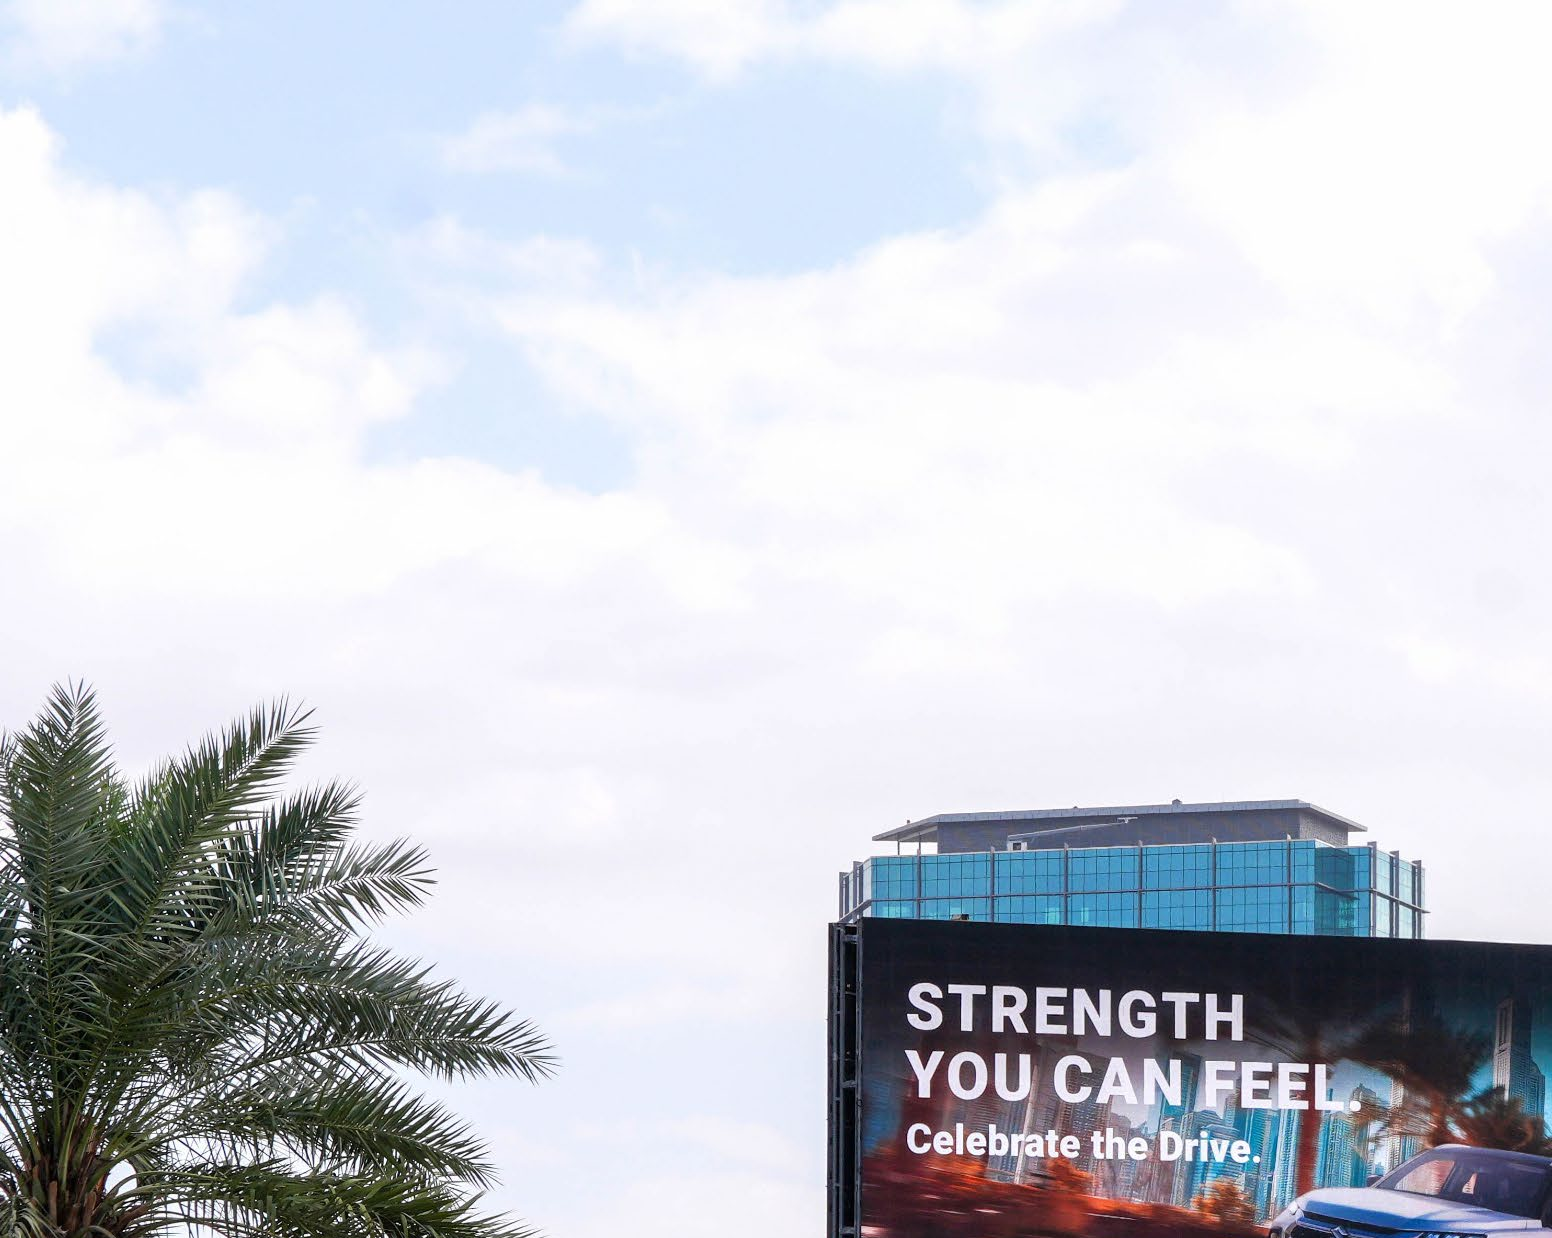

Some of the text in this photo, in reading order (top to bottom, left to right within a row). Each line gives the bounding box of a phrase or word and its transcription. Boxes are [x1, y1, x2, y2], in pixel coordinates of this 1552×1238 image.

[906, 982, 1243, 1041] STRENGTH
[904, 1049, 1362, 1113] YOU CAN FEEL.
[906, 1122, 1262, 1164] Celebrate the Drive.
